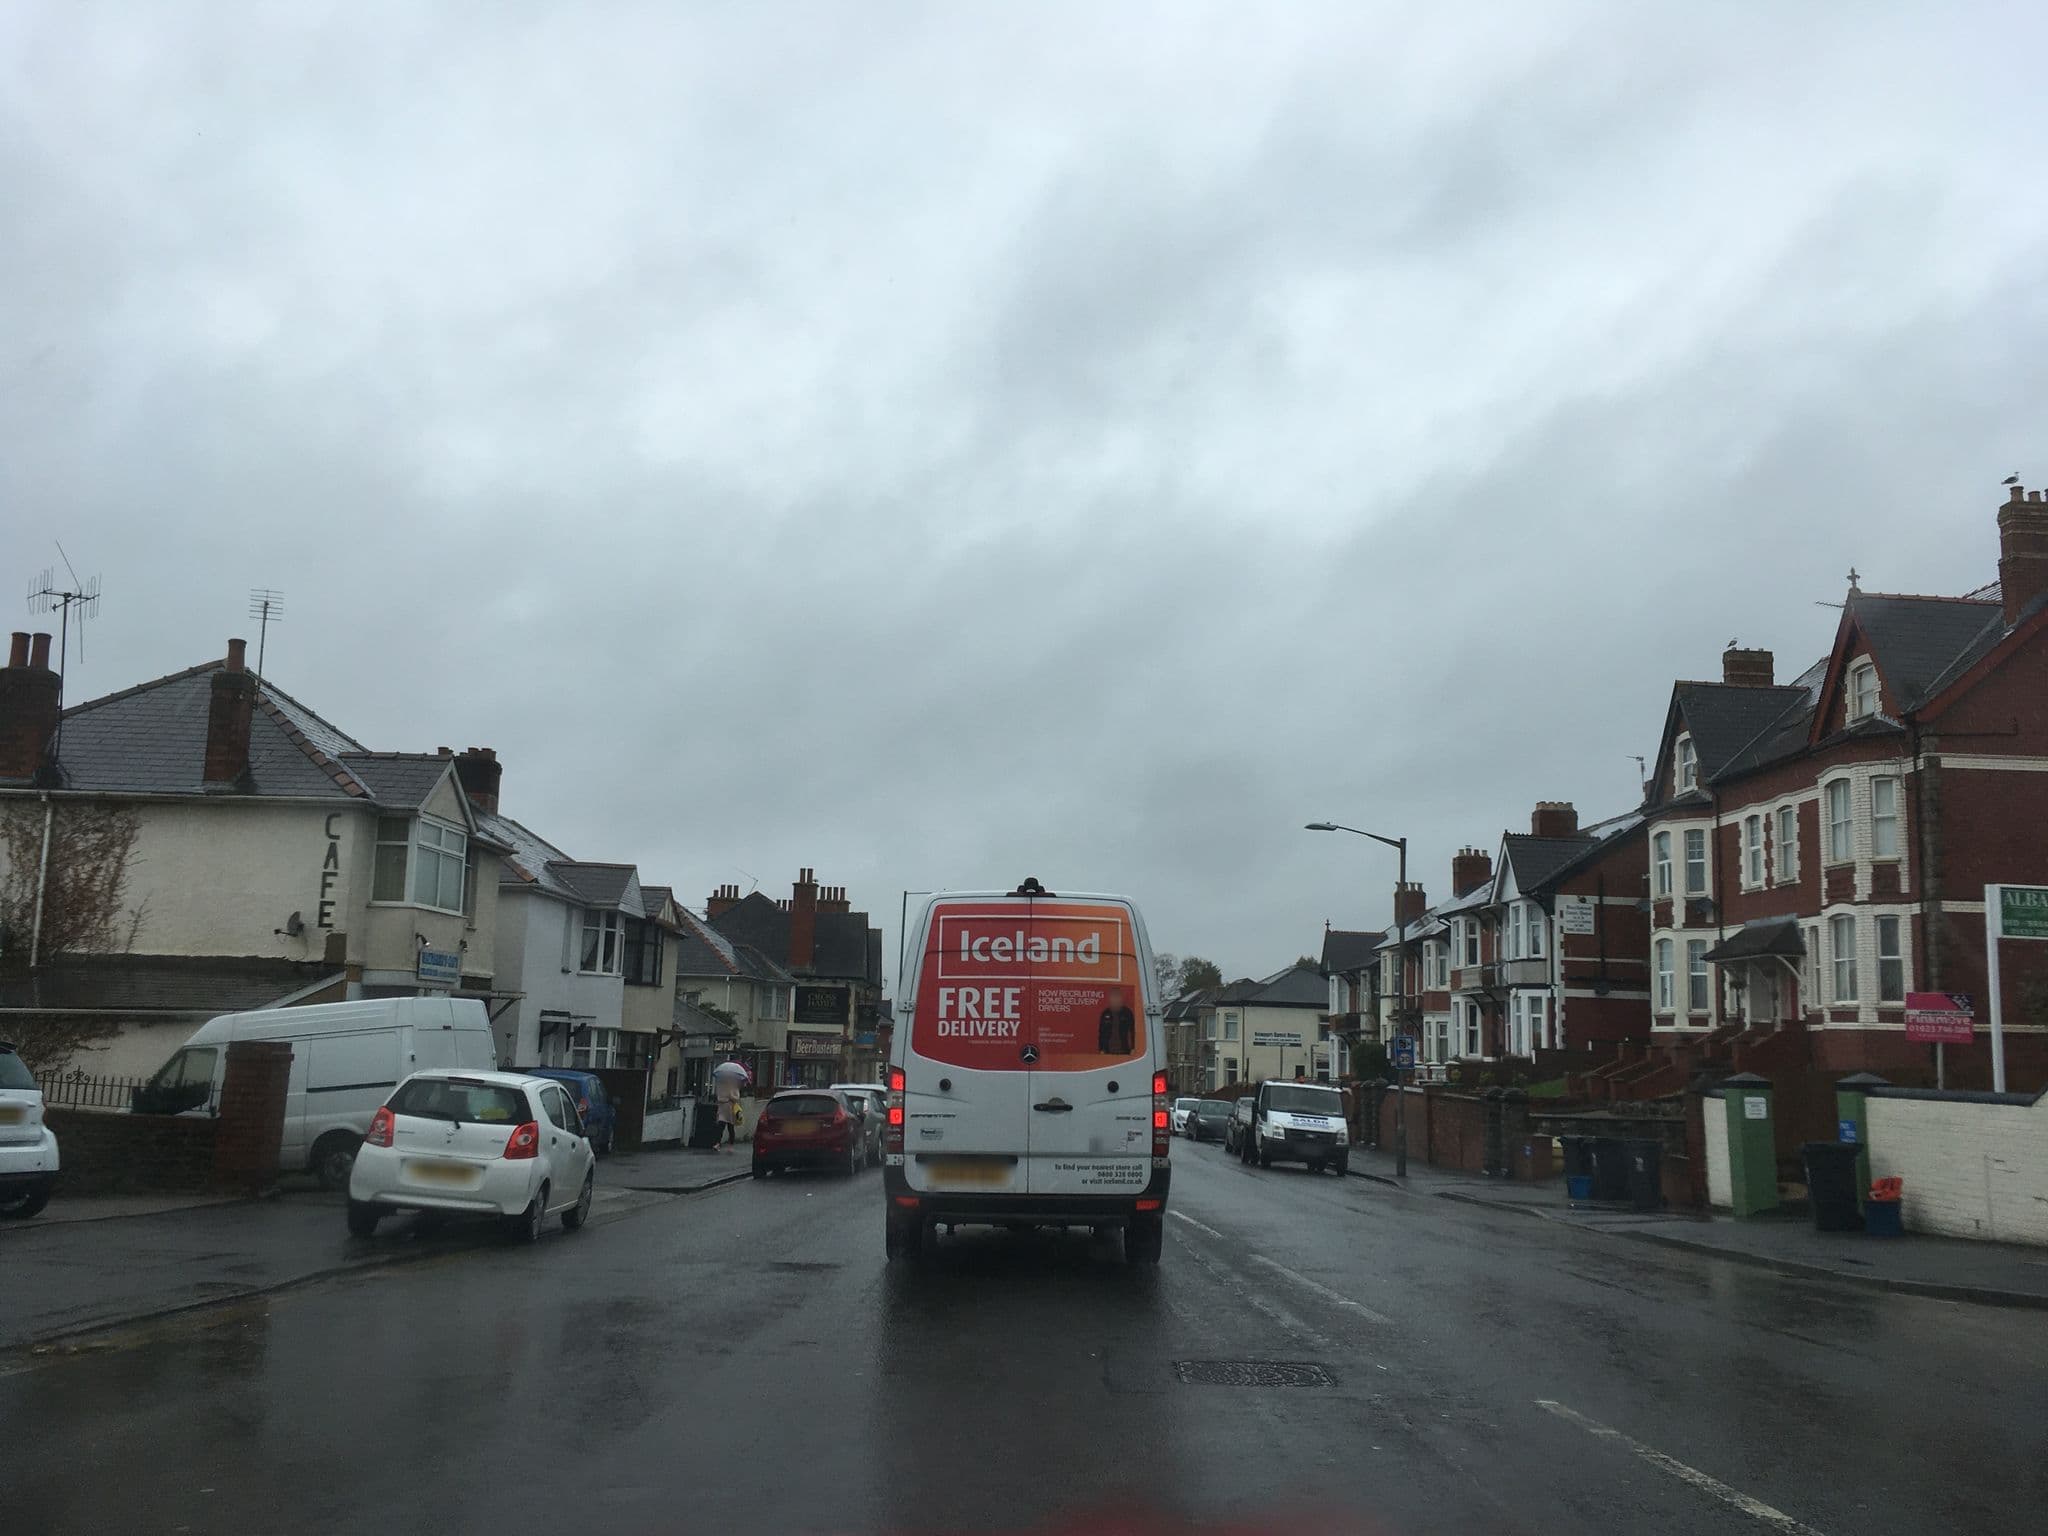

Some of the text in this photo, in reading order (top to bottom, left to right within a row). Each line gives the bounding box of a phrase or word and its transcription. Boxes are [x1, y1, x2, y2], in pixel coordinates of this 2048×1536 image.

[318, 812, 341, 928] CAFE
[961, 930, 1100, 964] Iceland
[1059, 990, 1104, 998] RECRUITING
[1064, 998, 1099, 1006] DELIVERY
[938, 987, 1021, 1019] FREE
[1039, 1005, 1071, 1013] DRIVERS
[938, 1020, 1021, 1037] DELIVERY
